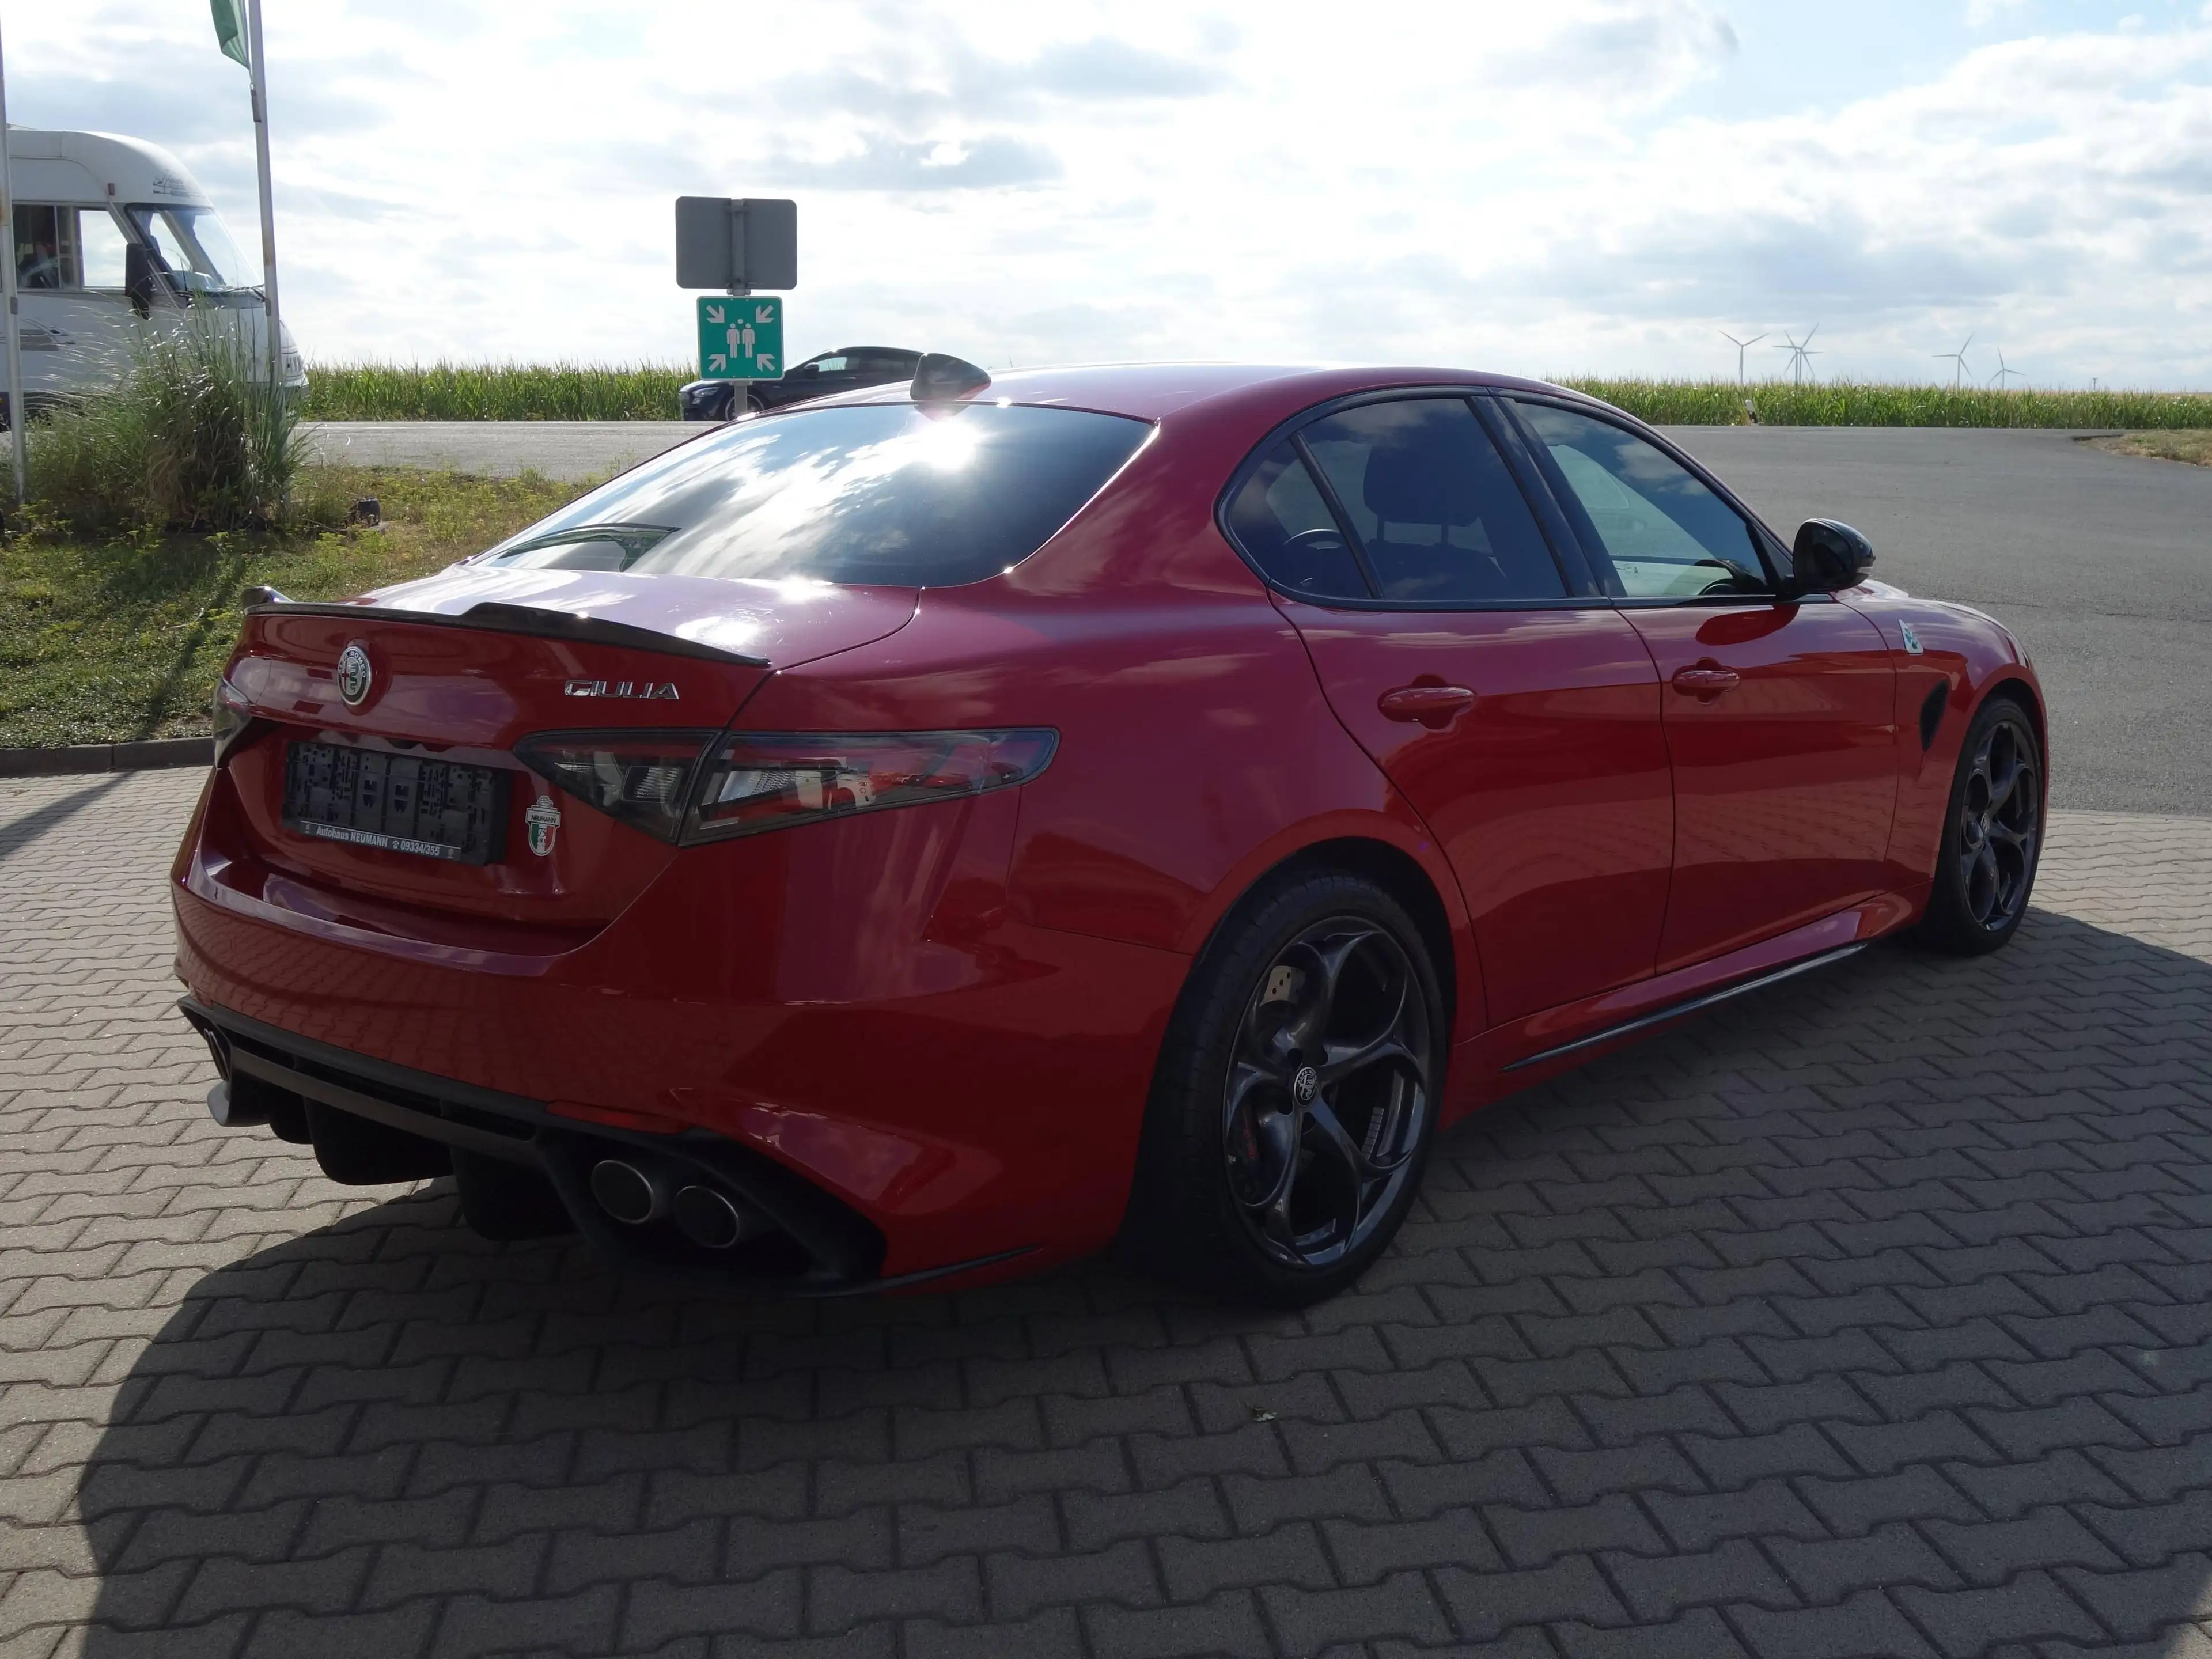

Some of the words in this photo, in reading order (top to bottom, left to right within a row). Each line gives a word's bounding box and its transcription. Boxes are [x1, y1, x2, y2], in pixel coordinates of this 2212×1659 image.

[350, 651, 366, 678] ROMEO
[565, 680, 679, 700] GIULIA
[531, 814, 556, 824] NEUMANN
[316, 825, 349, 840] Autohaus
[350, 831, 388, 847] NEUMANN
[400, 840, 440, 856] 09334/355
